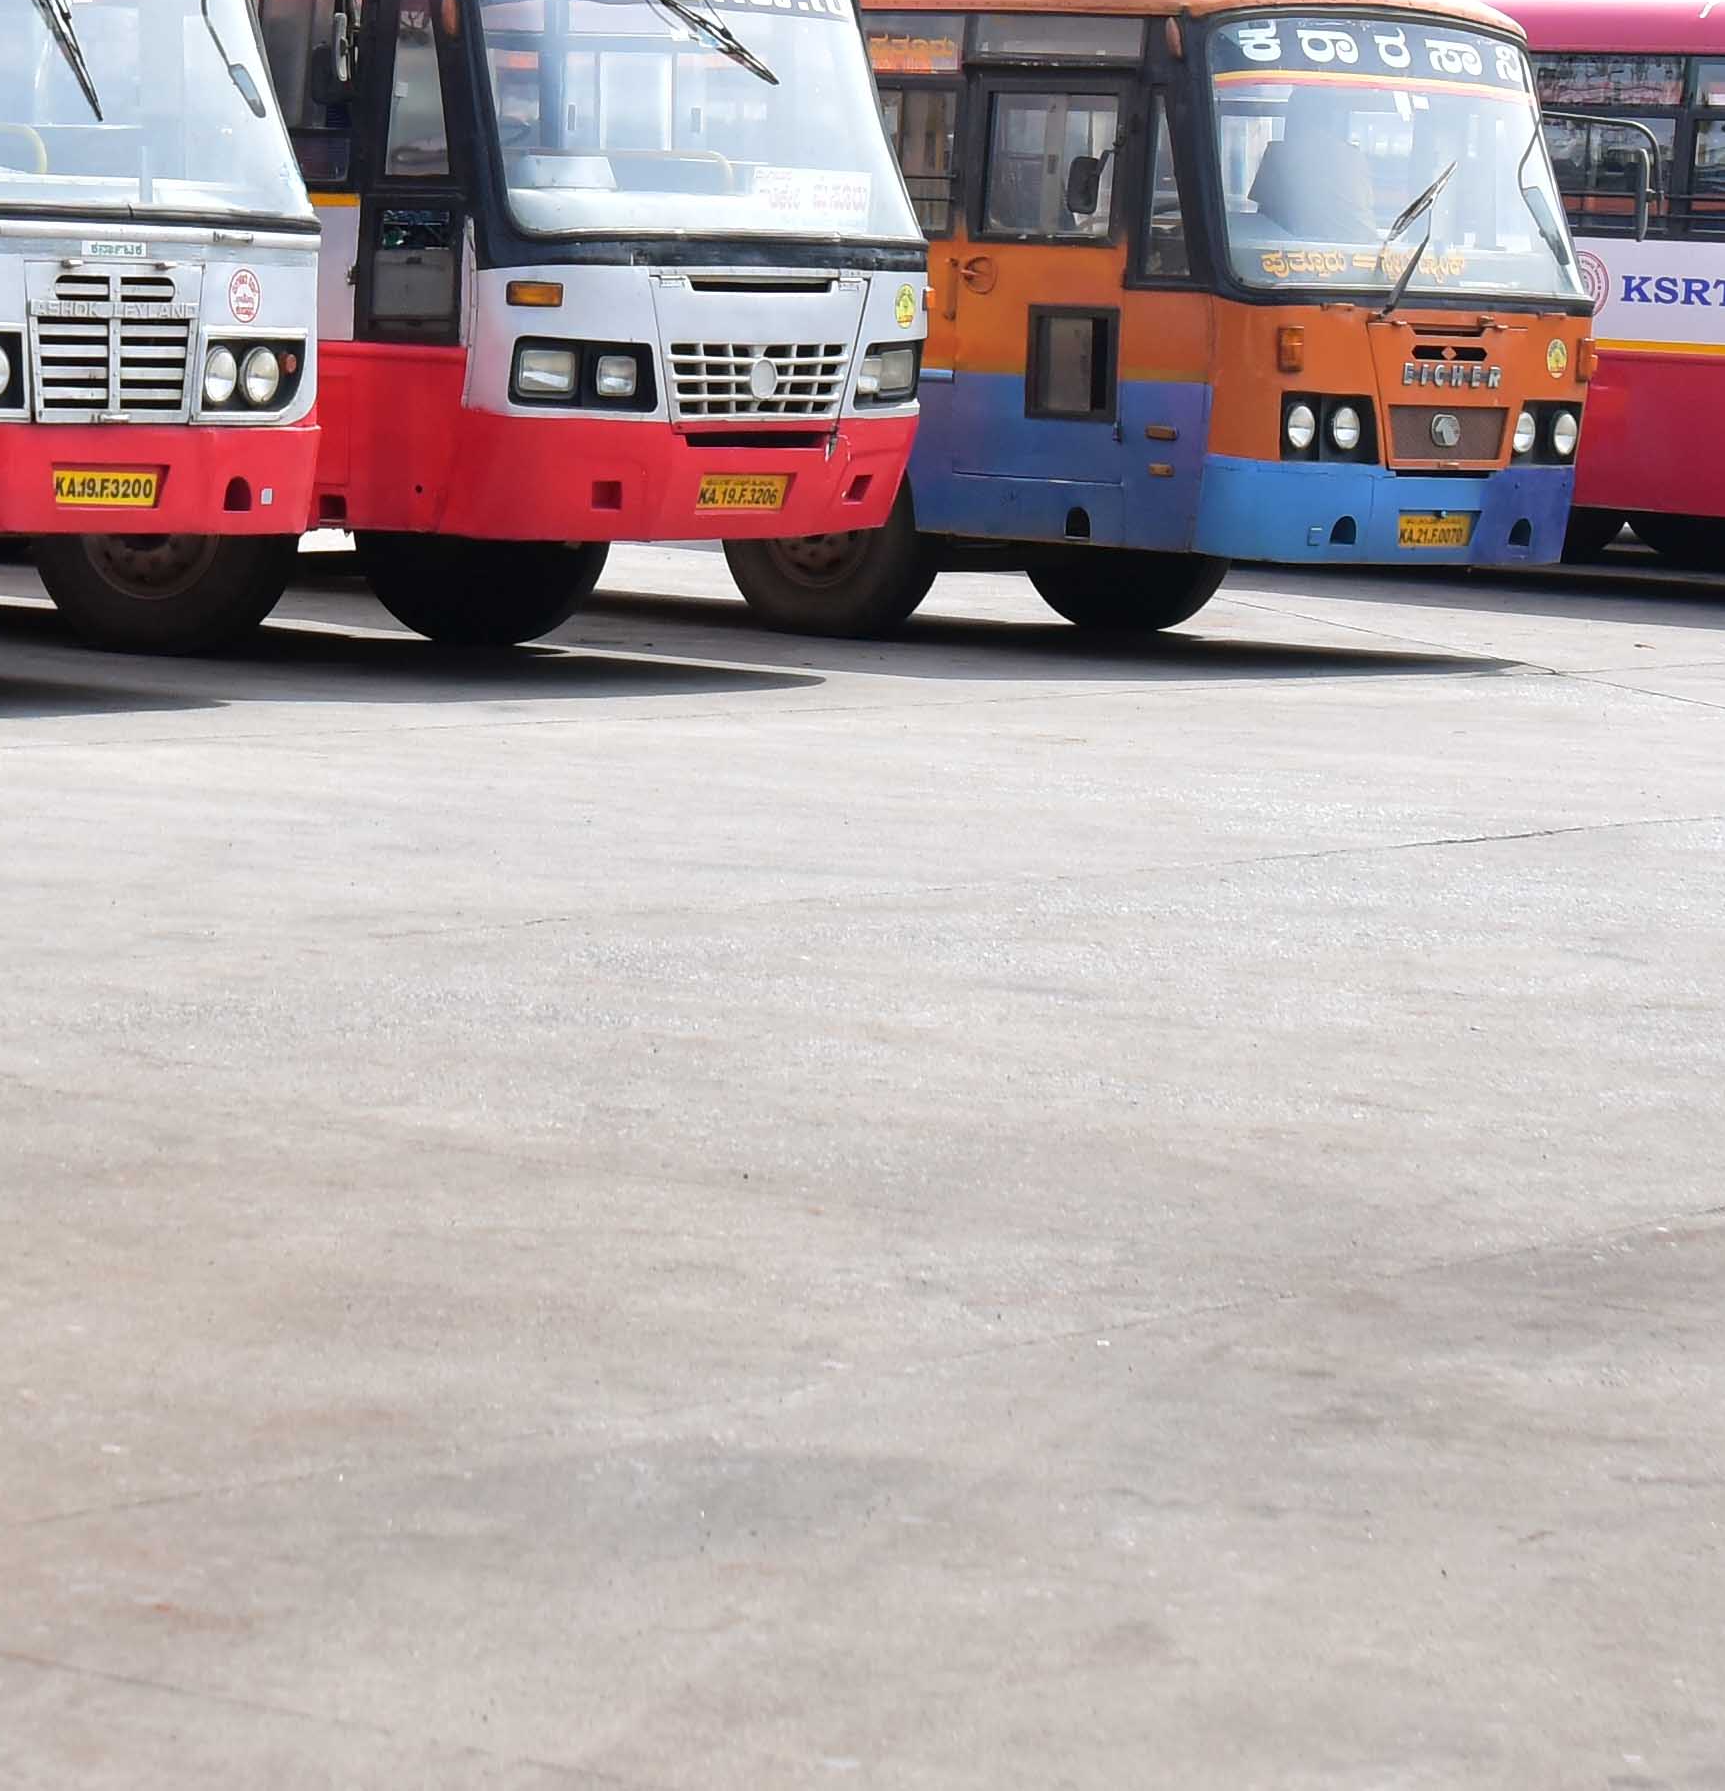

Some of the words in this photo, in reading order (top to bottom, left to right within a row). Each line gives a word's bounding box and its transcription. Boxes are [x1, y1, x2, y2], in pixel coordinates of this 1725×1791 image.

[37, 301, 98, 317] ASHOK
[111, 302, 196, 319] LEYLAND
[1403, 362, 1502, 389] EICHER
